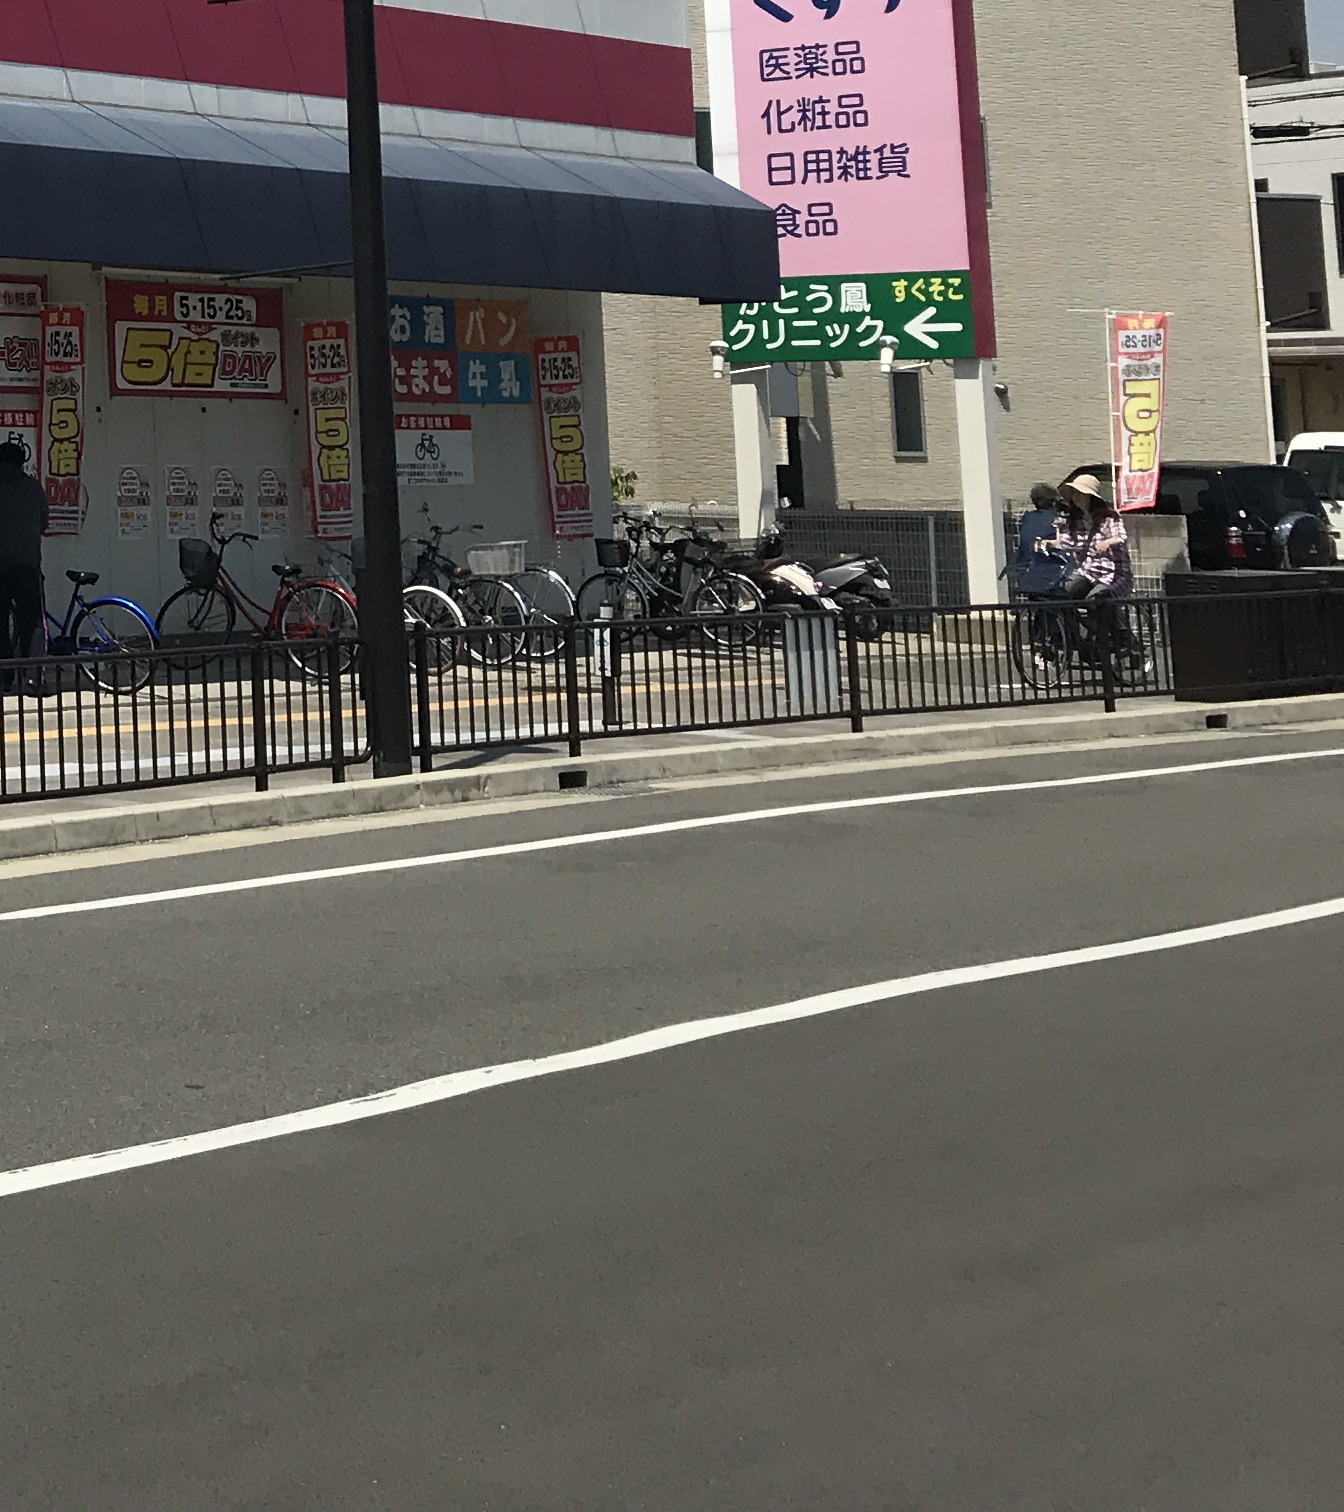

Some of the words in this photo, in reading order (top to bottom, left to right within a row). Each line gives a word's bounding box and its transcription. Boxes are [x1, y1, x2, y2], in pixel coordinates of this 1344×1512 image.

[759, 40, 866, 82] 医薬品
[761, 93, 869, 135] 化粧品
[766, 143, 912, 187] 日用雑貨
[775, 202, 839, 238] 食品
[133, 293, 168, 317] 毎月
[891, 277, 964, 303] すぐそこ
[389, 303, 446, 344] お酒
[464, 305, 517, 347] パン
[729, 316, 885, 351] クリニック
[120, 326, 220, 388] 5倍
[219, 350, 277, 382] DAY
[391, 354, 453, 395] たまご
[467, 358, 521, 398] 牛乳
[48, 396, 81, 478] 5倍
[315, 406, 350, 483] 5倍
[548, 414, 586, 485] 5倍
